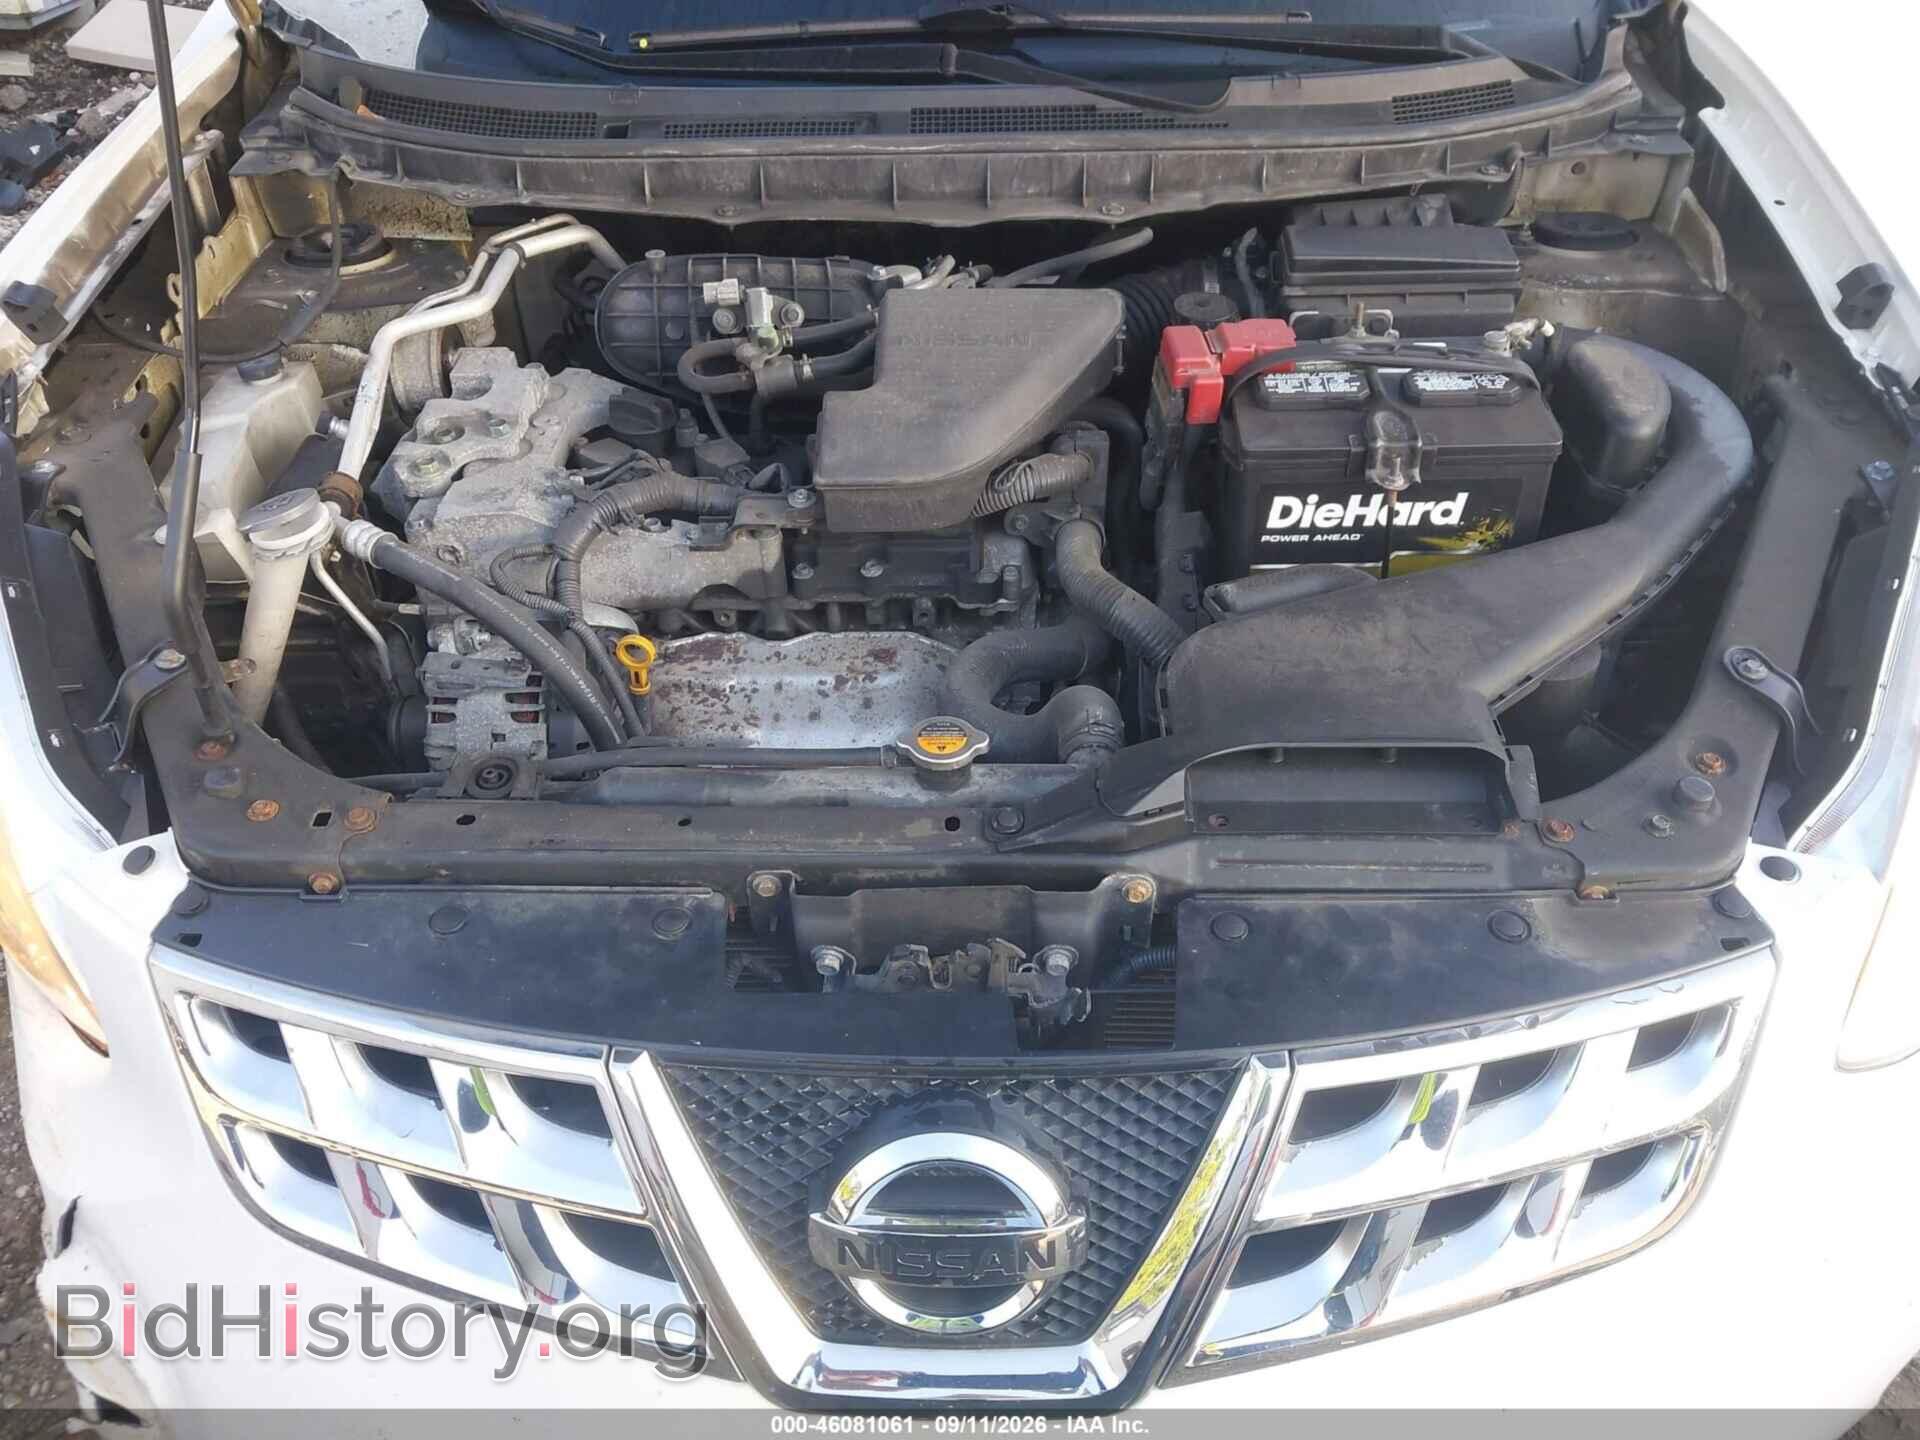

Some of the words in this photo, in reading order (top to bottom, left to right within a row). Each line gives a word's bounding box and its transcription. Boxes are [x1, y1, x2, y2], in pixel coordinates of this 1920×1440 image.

[897, 333, 1032, 349] NISSAN
[1265, 492, 1469, 529] DieHard
[1260, 533, 1309, 543] POWER
[1313, 532, 1361, 542] AHEAD
[837, 1238, 1057, 1281] NISSAN
